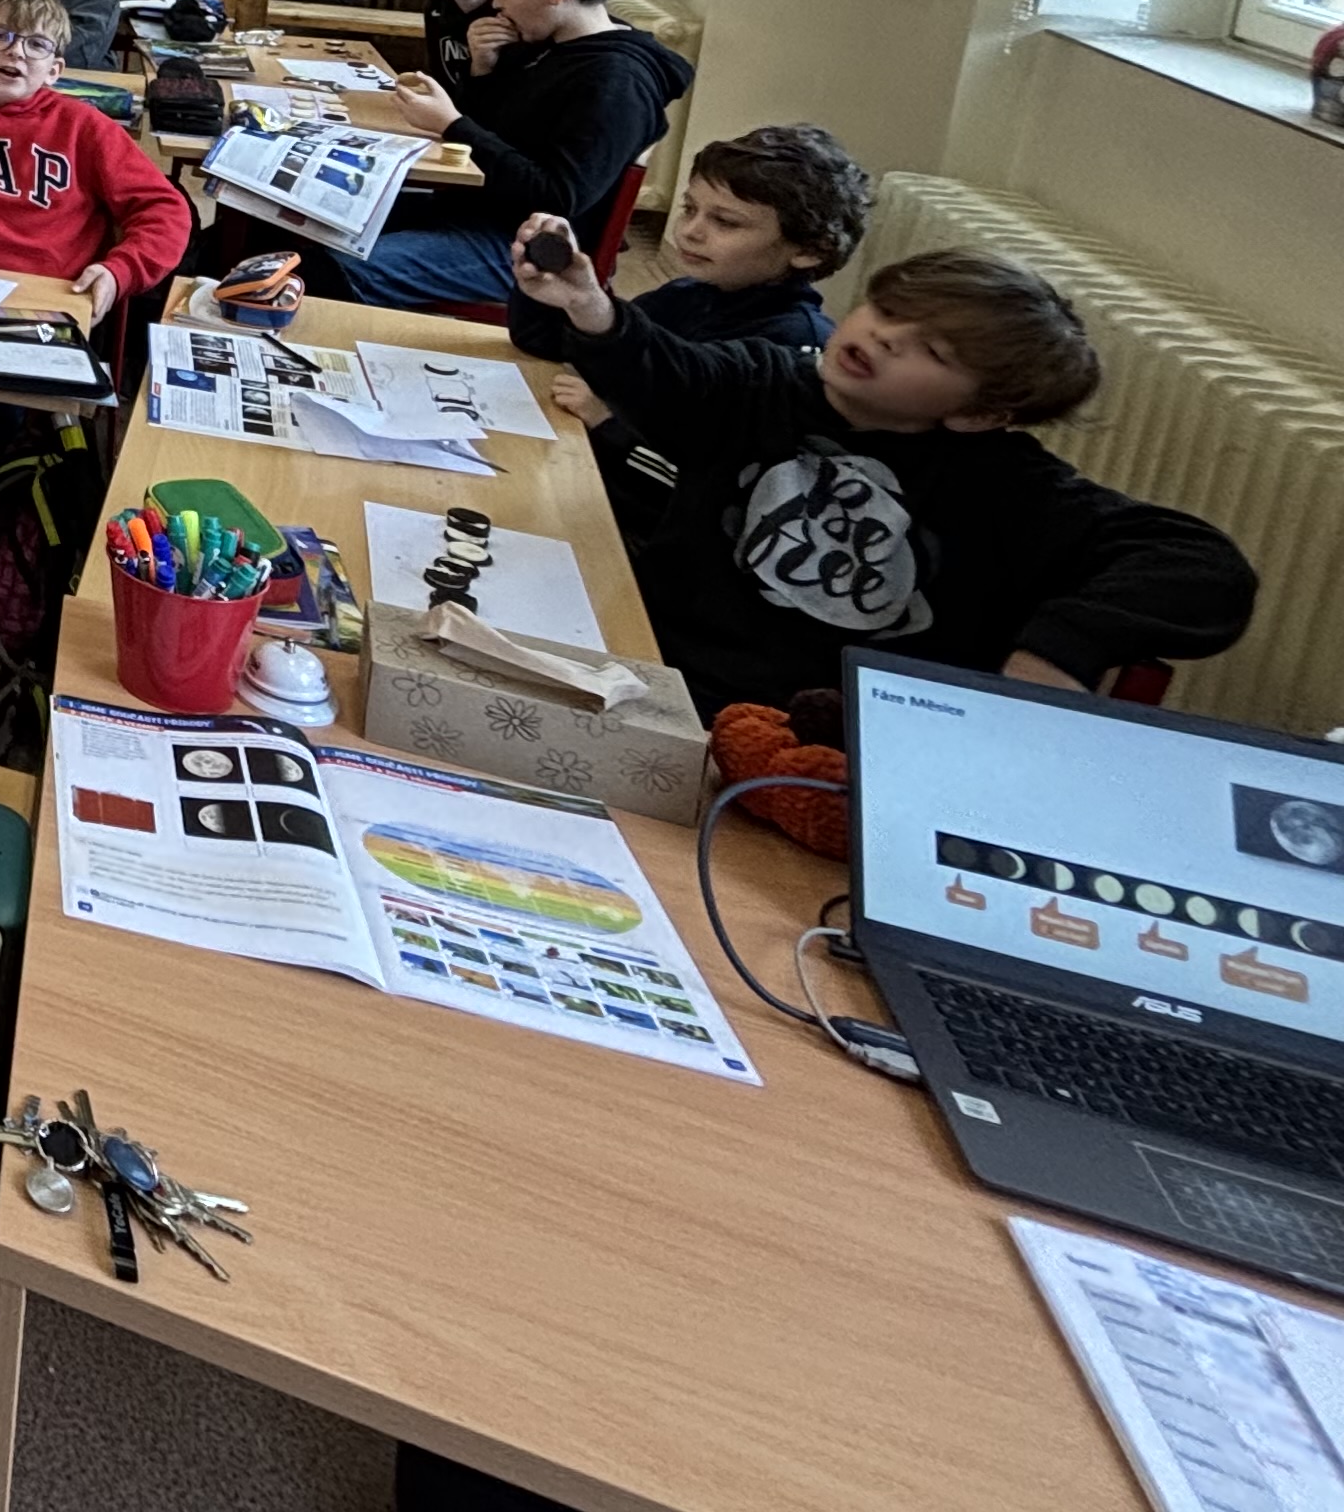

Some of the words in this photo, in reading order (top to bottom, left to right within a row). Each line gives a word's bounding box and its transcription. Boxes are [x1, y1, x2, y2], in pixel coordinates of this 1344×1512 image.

[872, 687, 906, 705] Fáze
[909, 695, 966, 718] Měsíce
[1131, 995, 1204, 1024] ASUS
